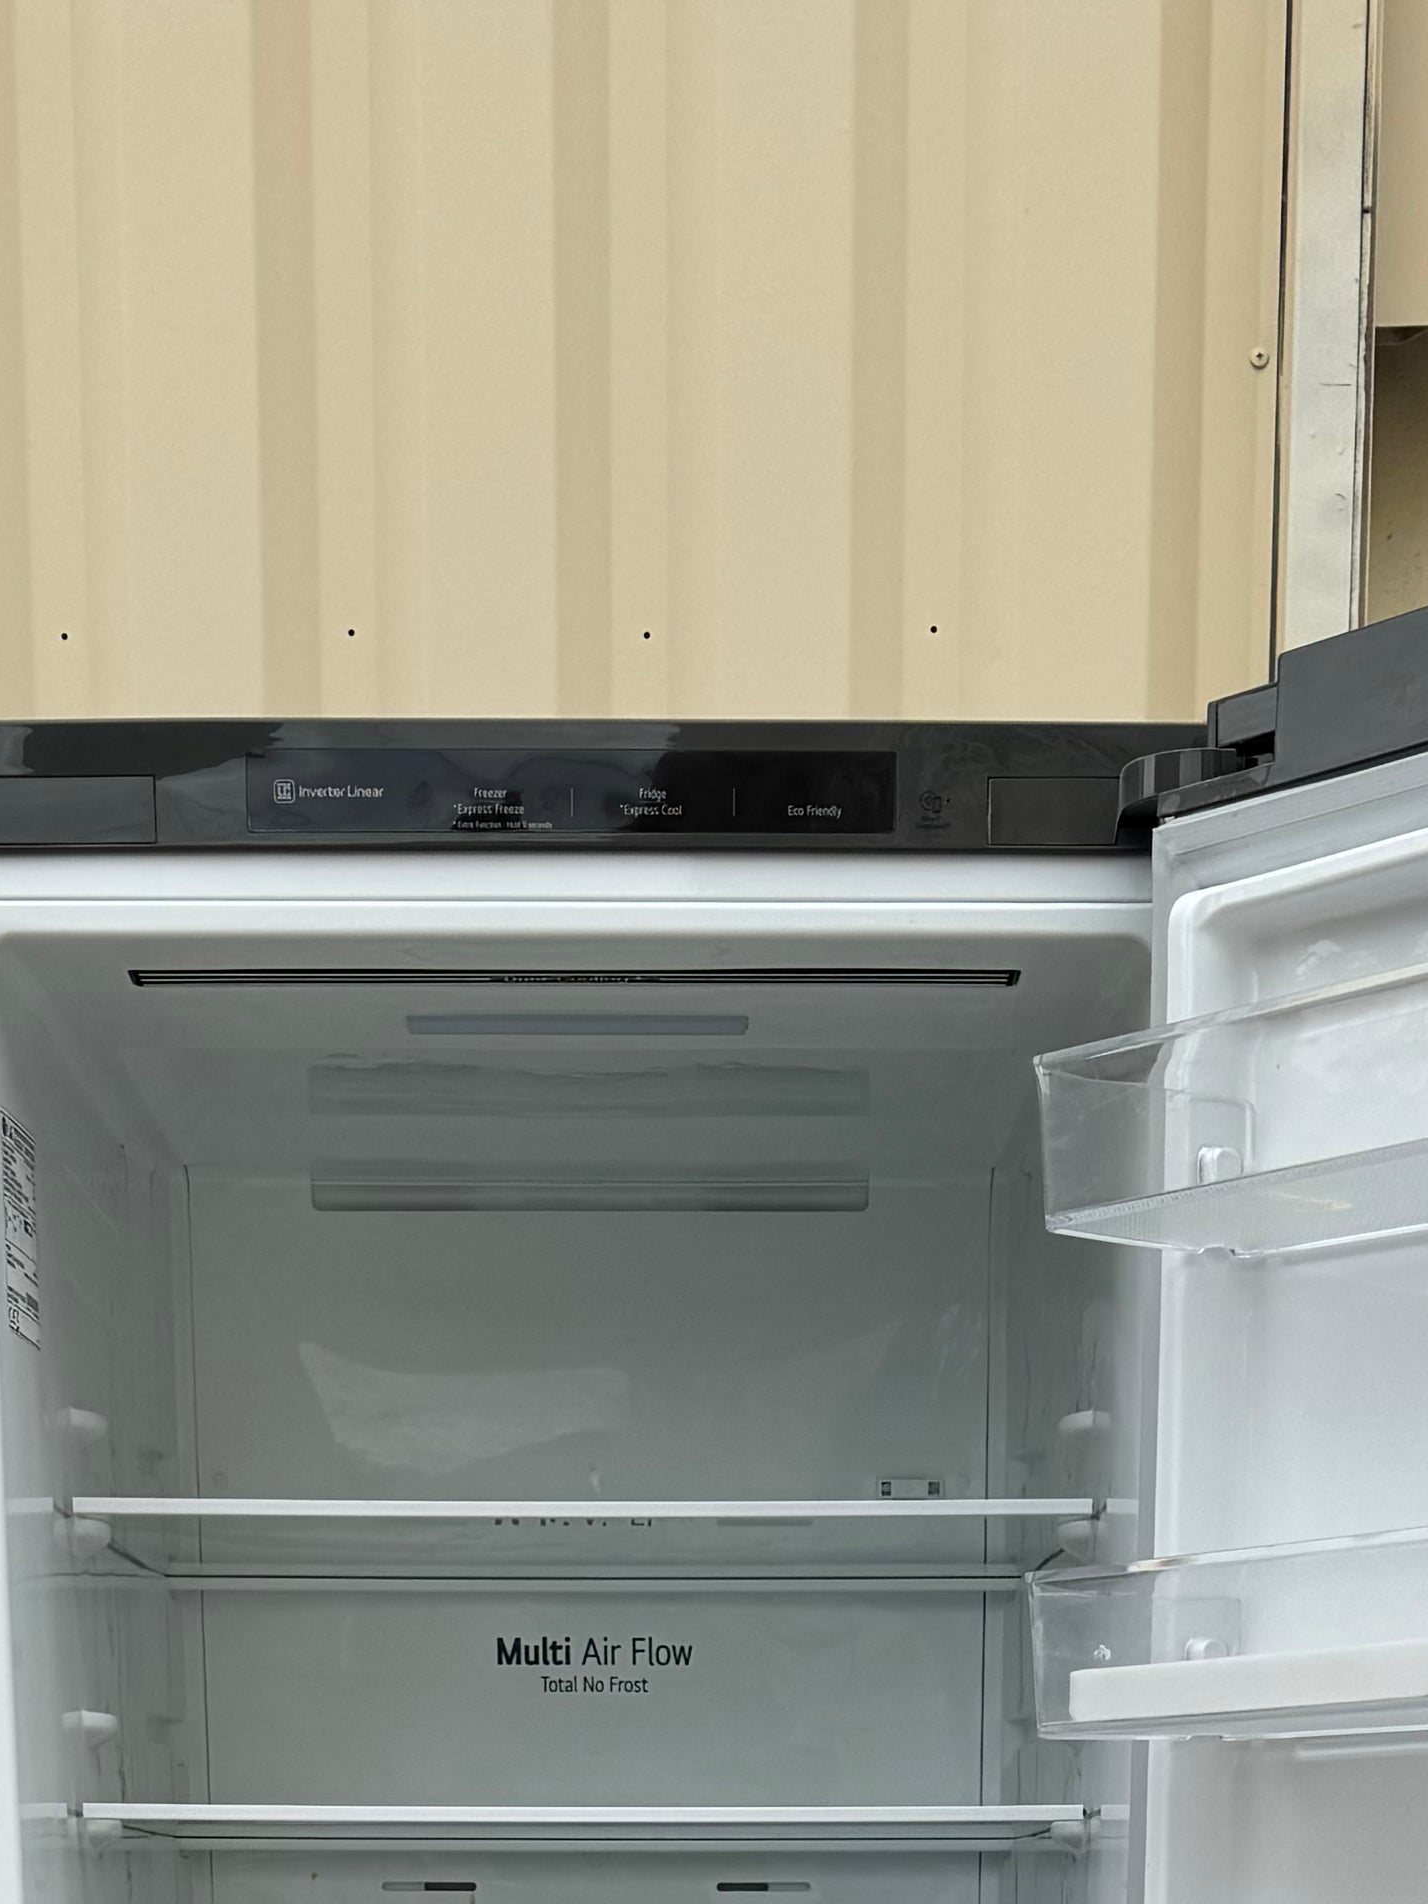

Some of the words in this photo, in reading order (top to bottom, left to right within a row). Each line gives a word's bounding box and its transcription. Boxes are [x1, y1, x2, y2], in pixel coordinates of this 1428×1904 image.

[299, 785, 345, 797] Inverter
[347, 785, 384, 798] Linear
[474, 788, 507, 798] Freezer
[639, 788, 667, 802] Fridge
[495, 803, 524, 814] Freeze
[661, 804, 682, 815] Cool
[788, 805, 804, 816] Eco
[807, 805, 842, 819] Friendly
[497, 1637, 571, 1666] Multi
[582, 1637, 621, 1666] Air
[631, 1637, 693, 1666] Flow
[541, 1676, 578, 1693] Total
[583, 1676, 604, 1693] No
[609, 1676, 648, 1693] Frost
